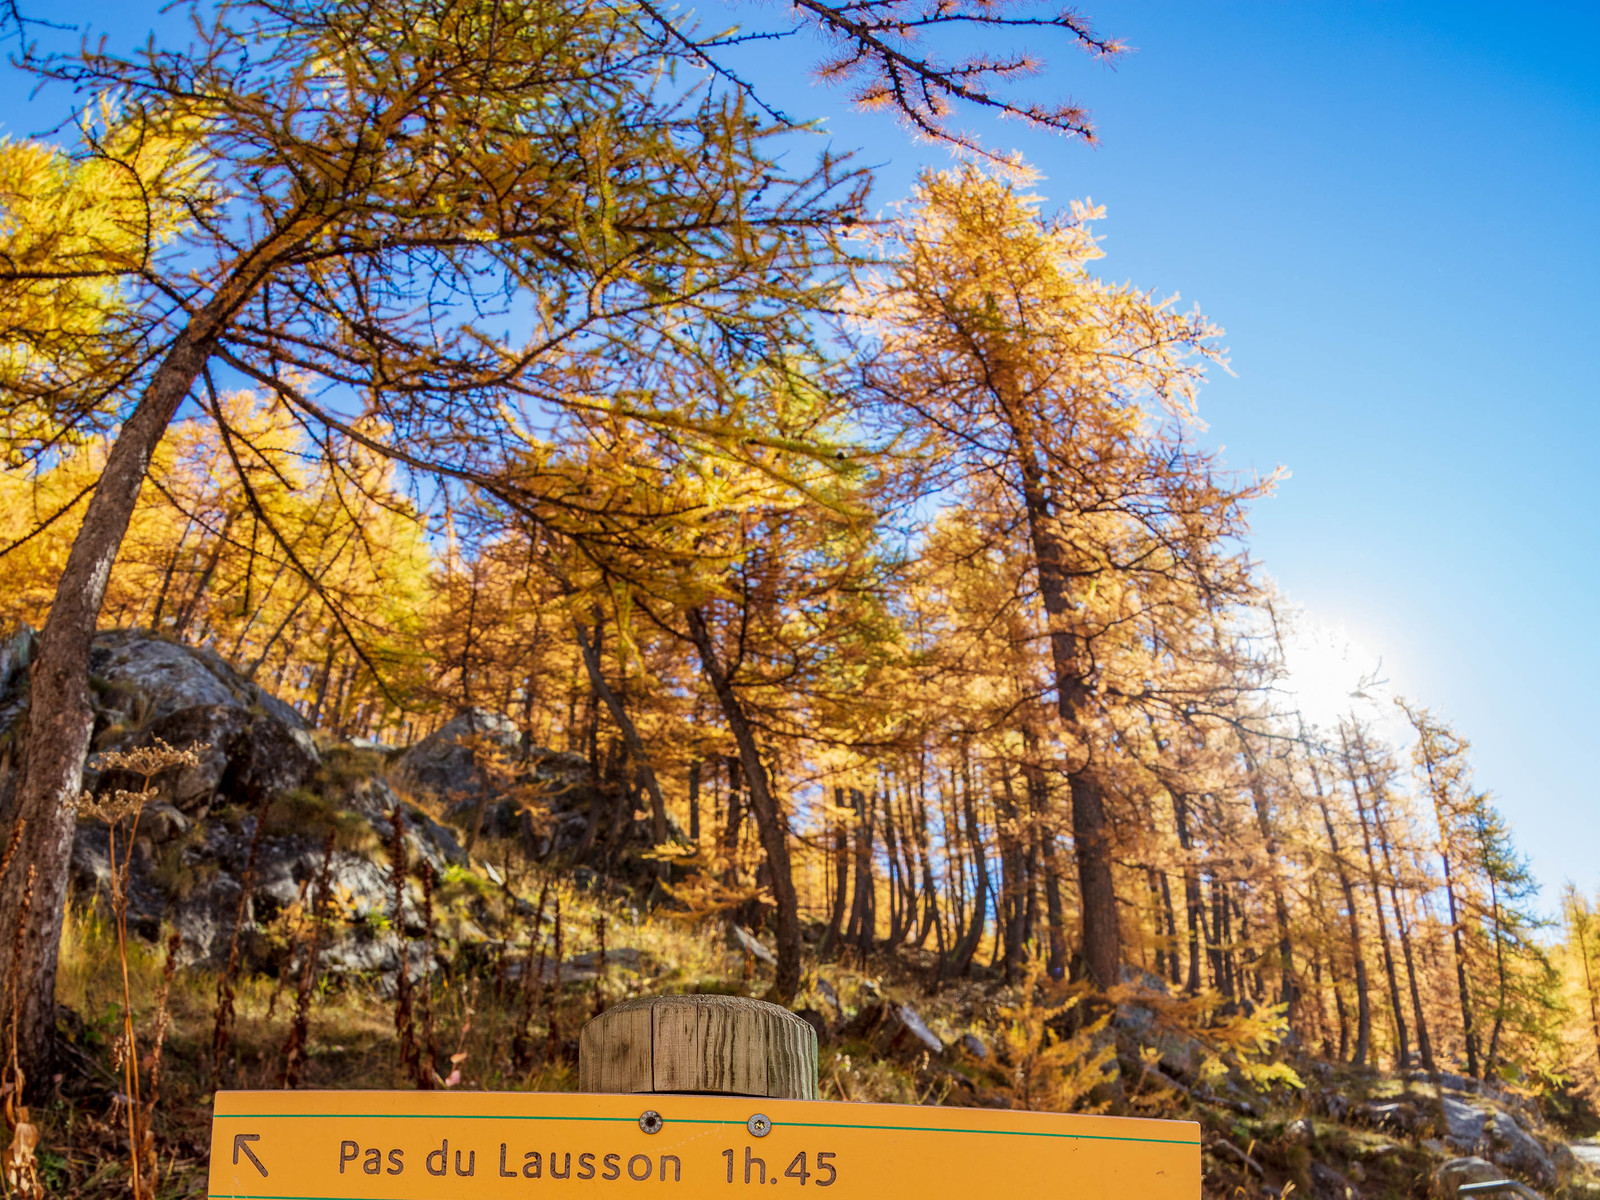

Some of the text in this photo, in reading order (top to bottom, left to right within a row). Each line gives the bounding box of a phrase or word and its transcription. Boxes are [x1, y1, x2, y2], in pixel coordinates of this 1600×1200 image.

[338, 1138, 837, 1187] Pas du Lausson 1h.45
